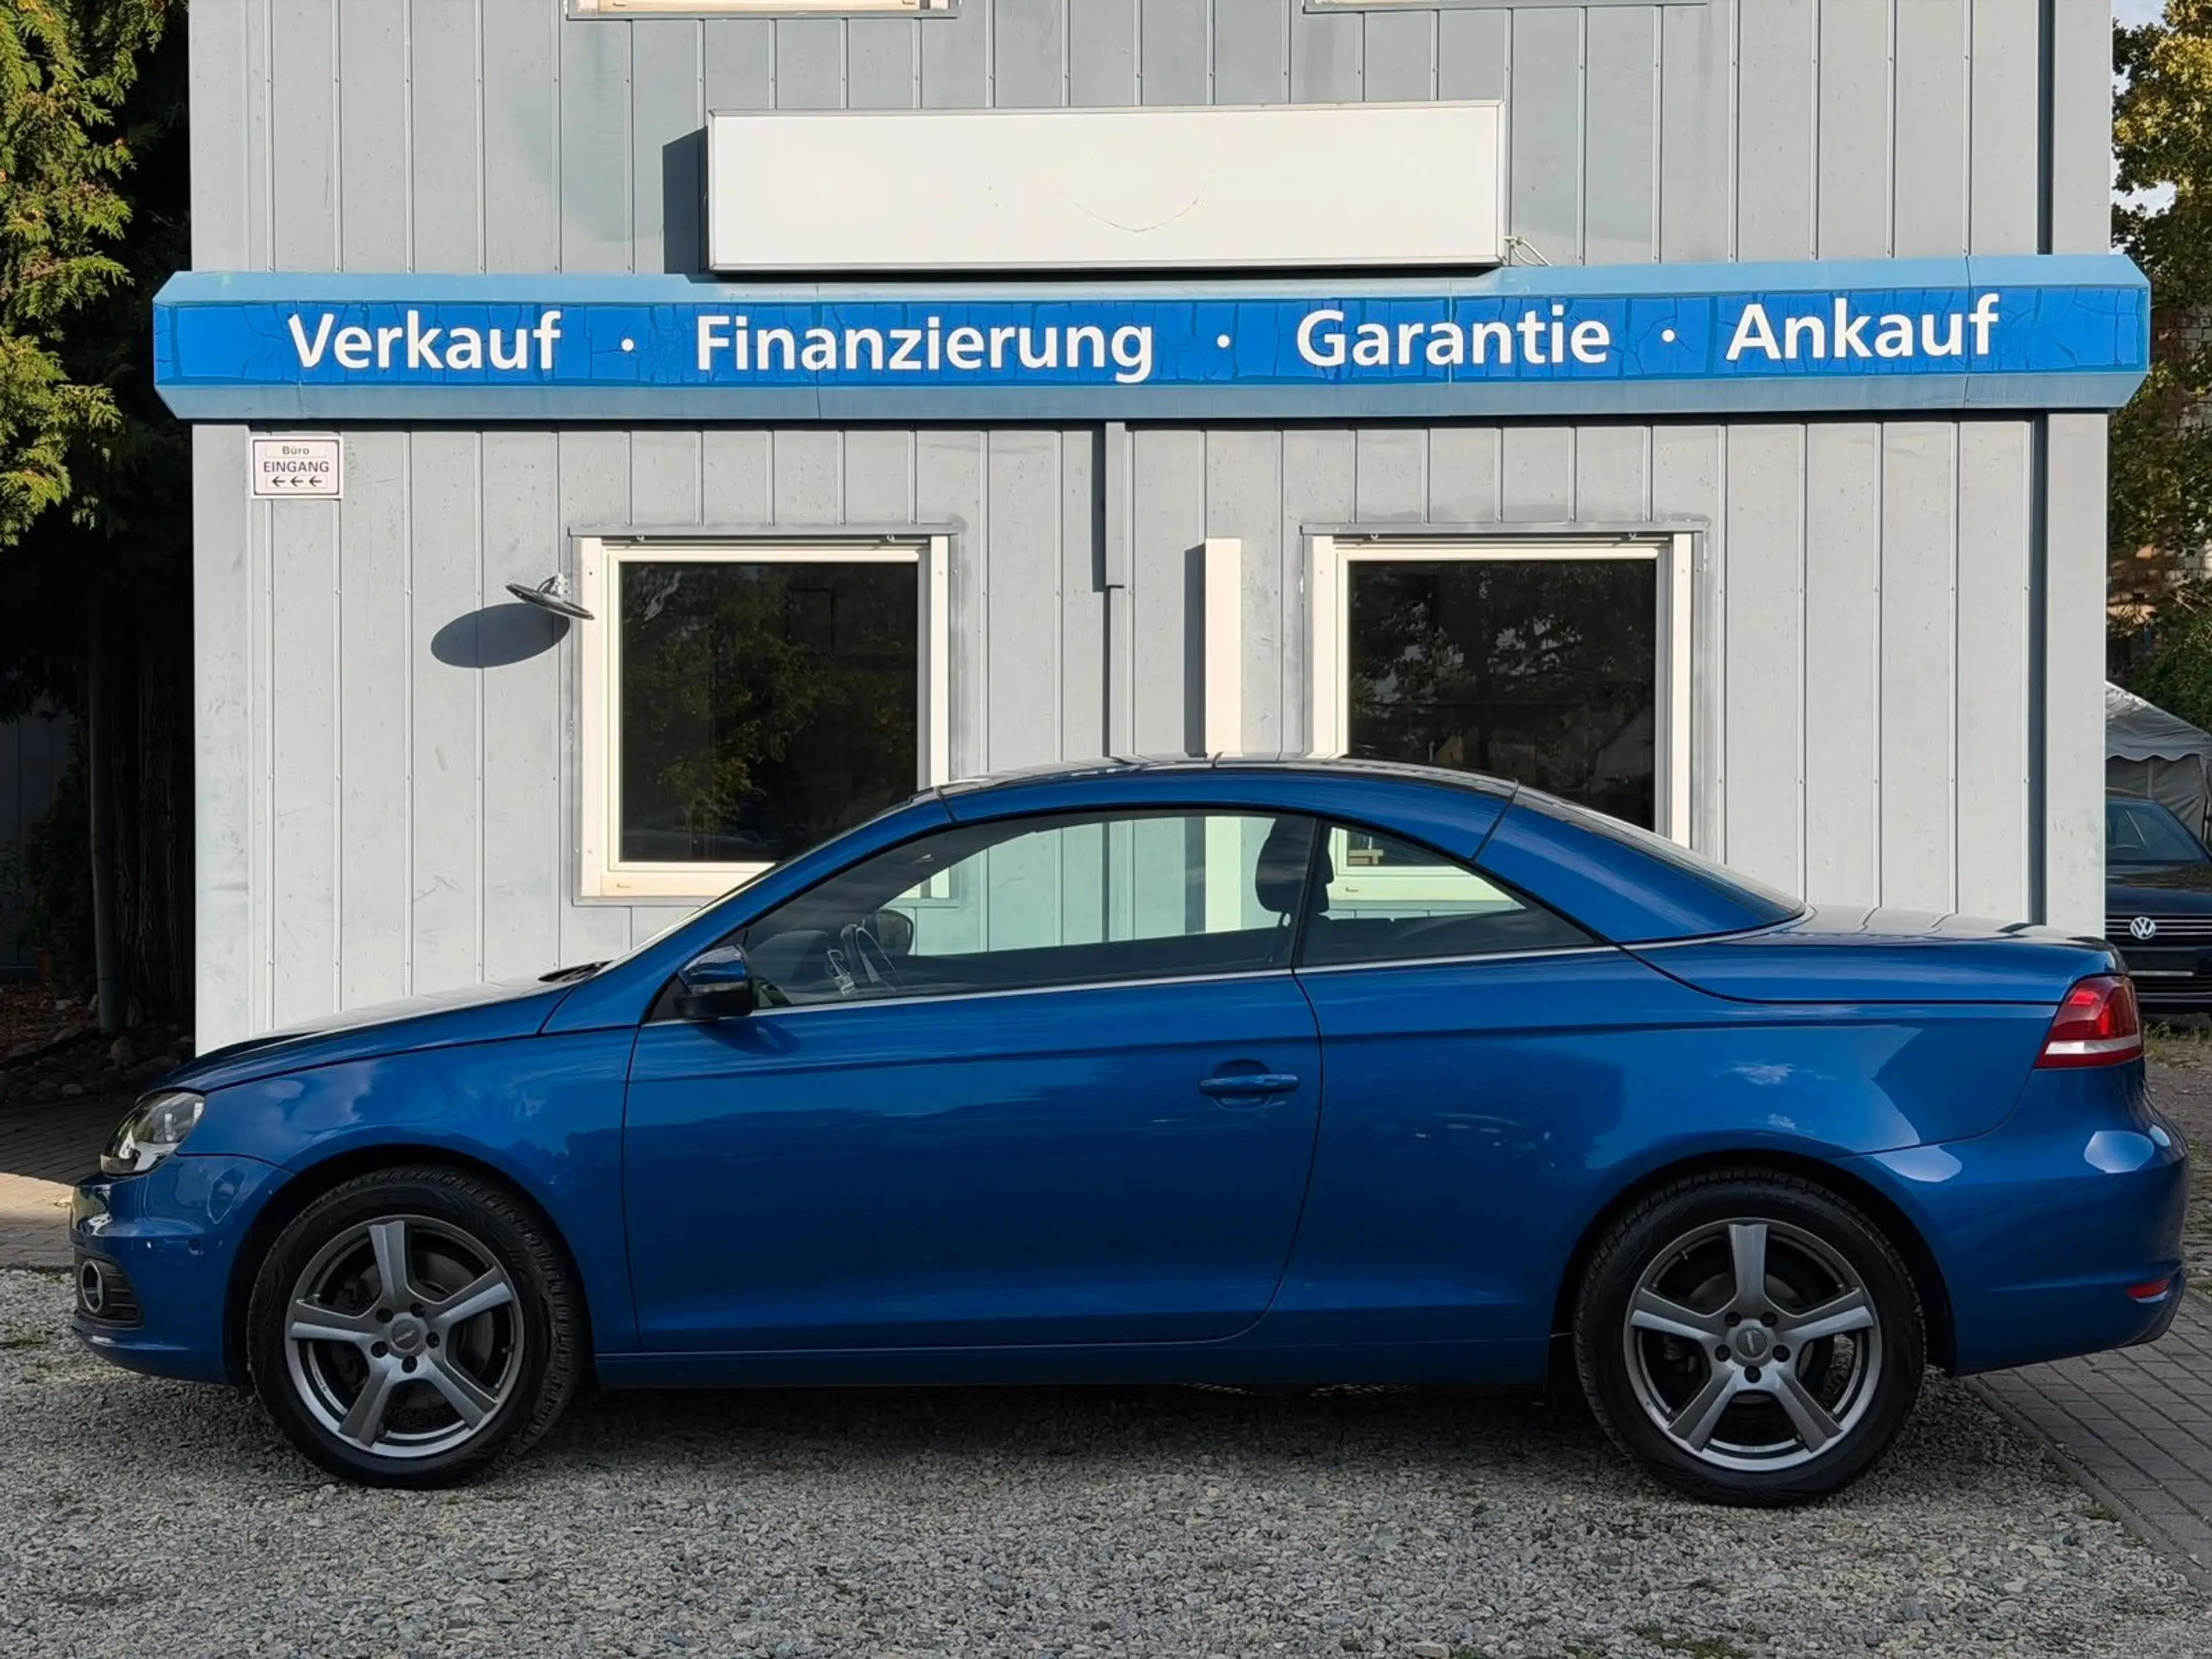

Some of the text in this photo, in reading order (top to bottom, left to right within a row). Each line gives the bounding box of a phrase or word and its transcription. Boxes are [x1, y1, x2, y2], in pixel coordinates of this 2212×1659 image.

[288, 293, 2000, 384] Verkauf Finanzierung Garantie Ankauf
[263, 461, 329, 473] EINGANG
